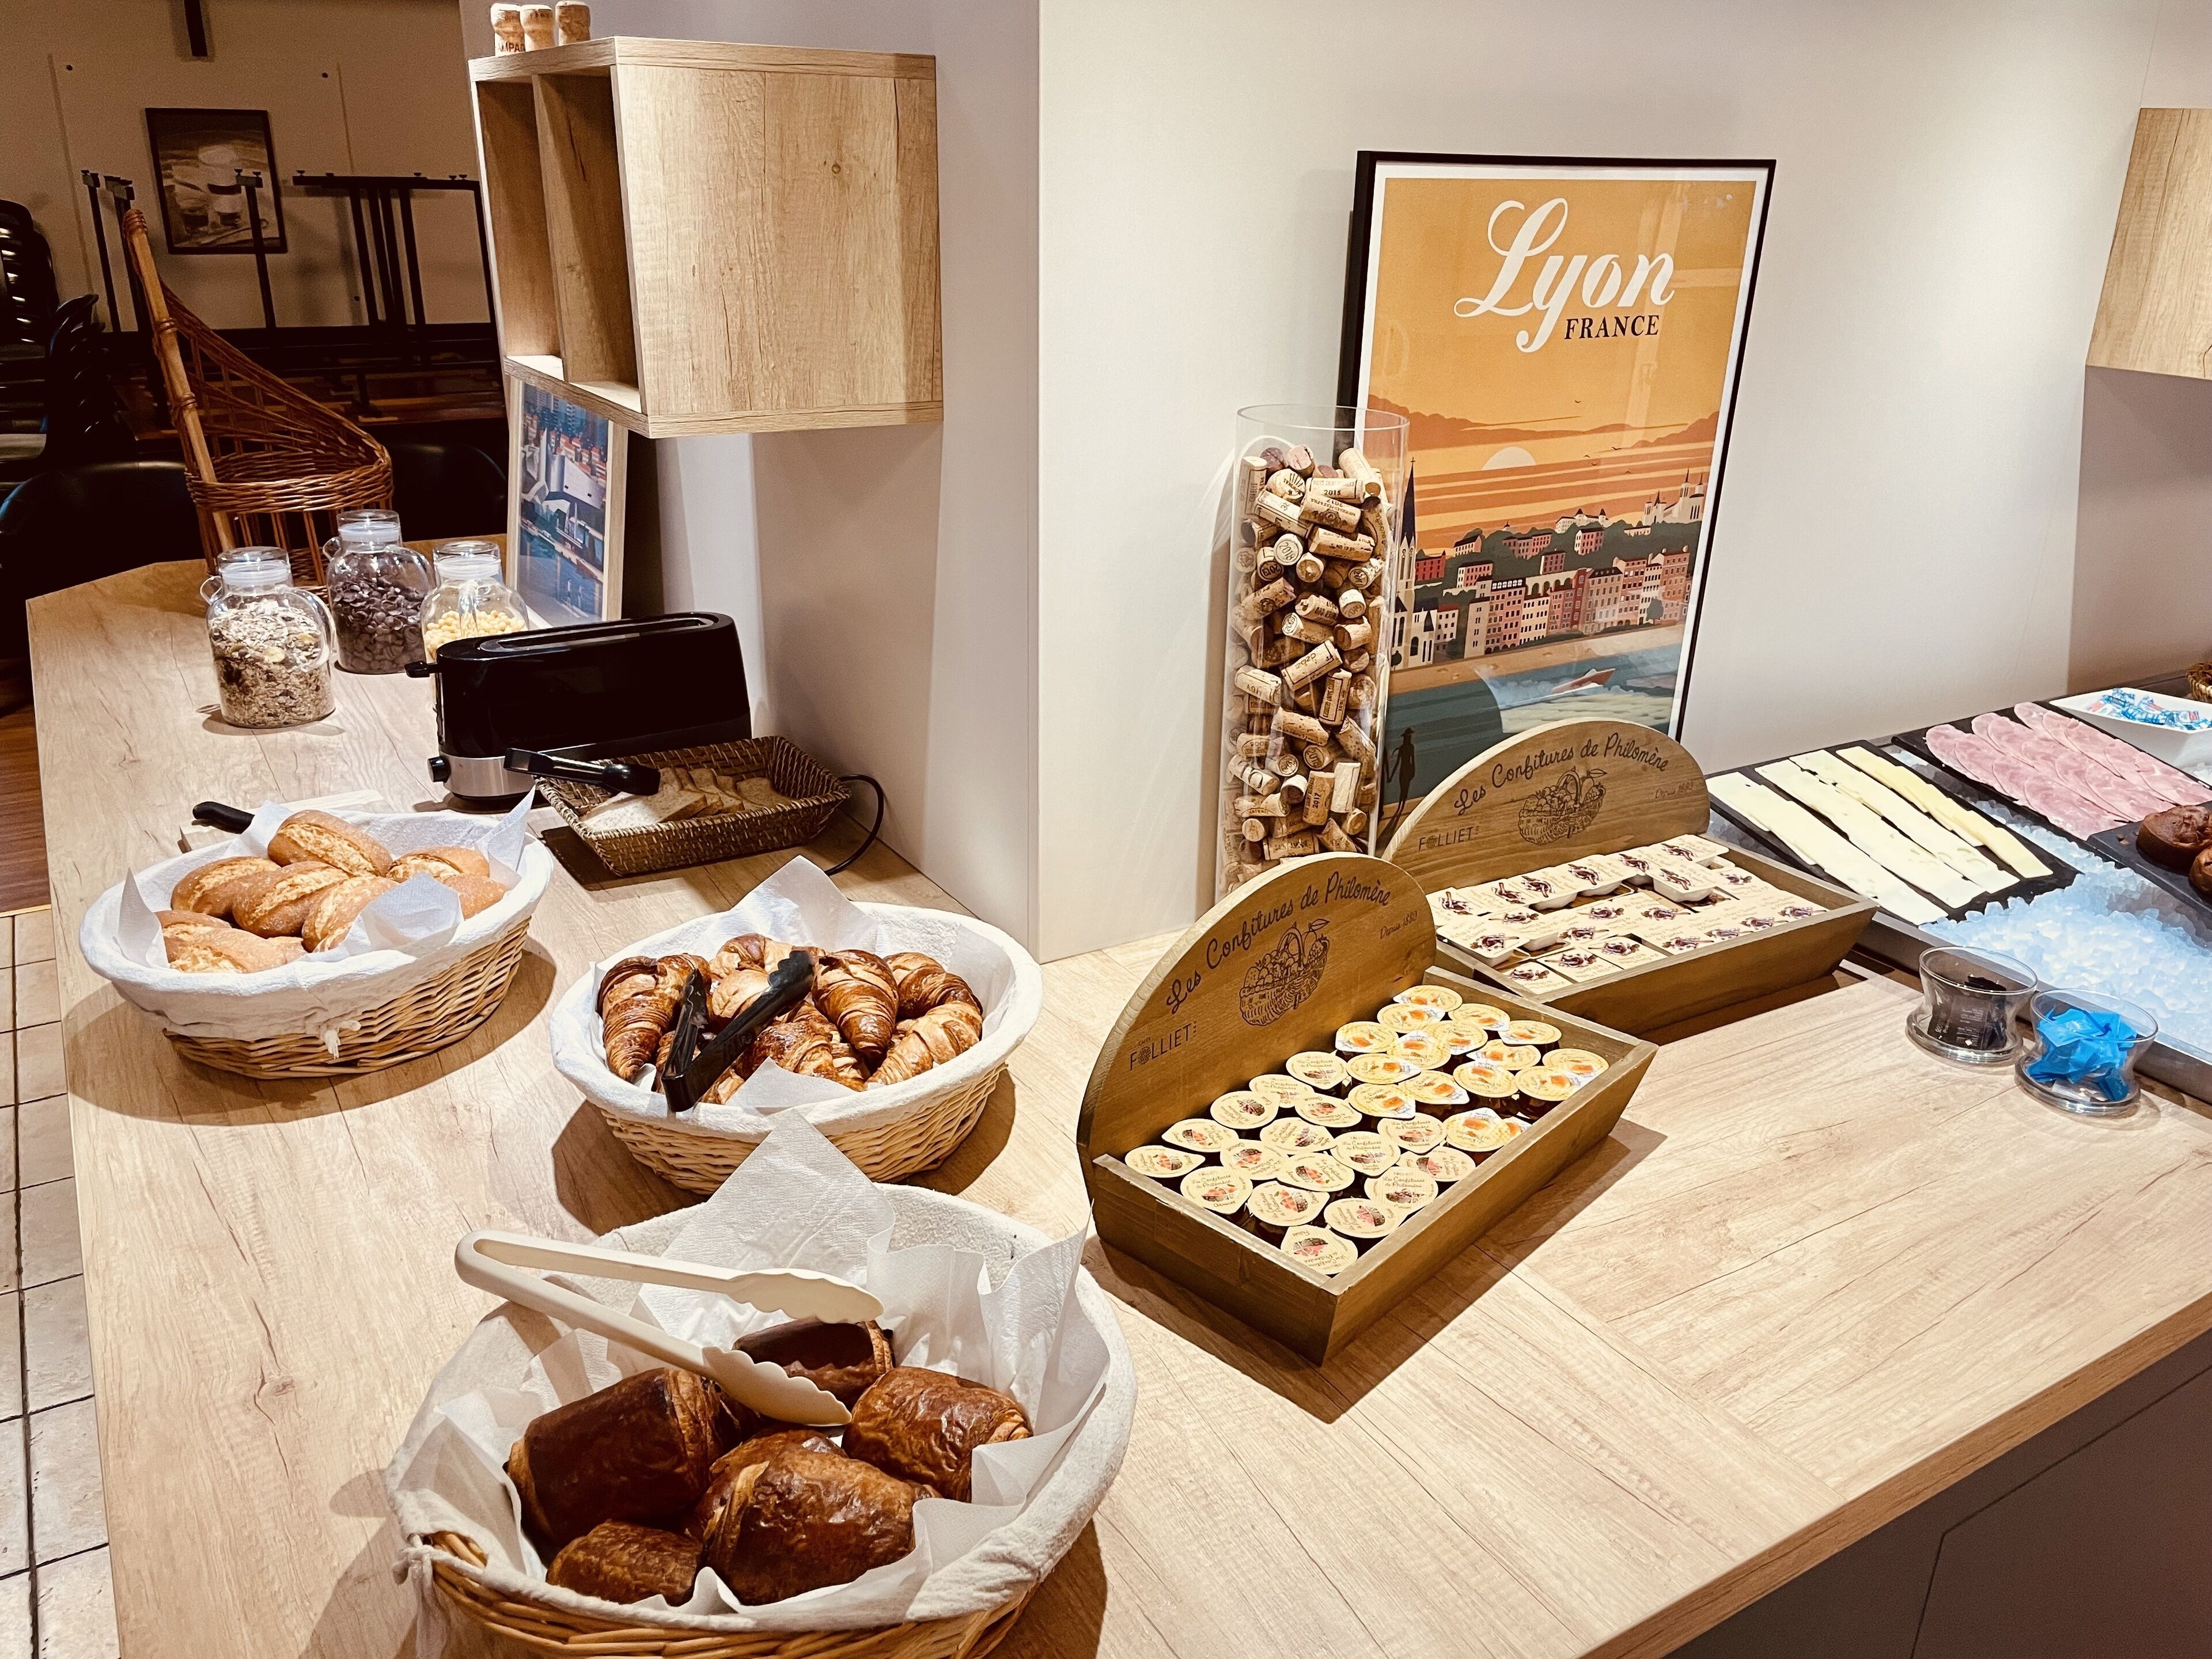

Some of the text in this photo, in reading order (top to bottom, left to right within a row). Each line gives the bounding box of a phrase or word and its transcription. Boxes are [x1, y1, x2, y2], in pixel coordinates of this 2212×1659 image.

[1453, 198, 1675, 353] Lyon
[1564, 315, 1660, 340] FRANCE
[1279, 542, 1296, 560] 2018
[1295, 653, 1316, 669] 2020
[1454, 732, 1670, 816] Les Confitures de Philomène
[1313, 792, 1321, 809] 2017
[1166, 871, 1392, 1014] Les Confitures de Philomène
